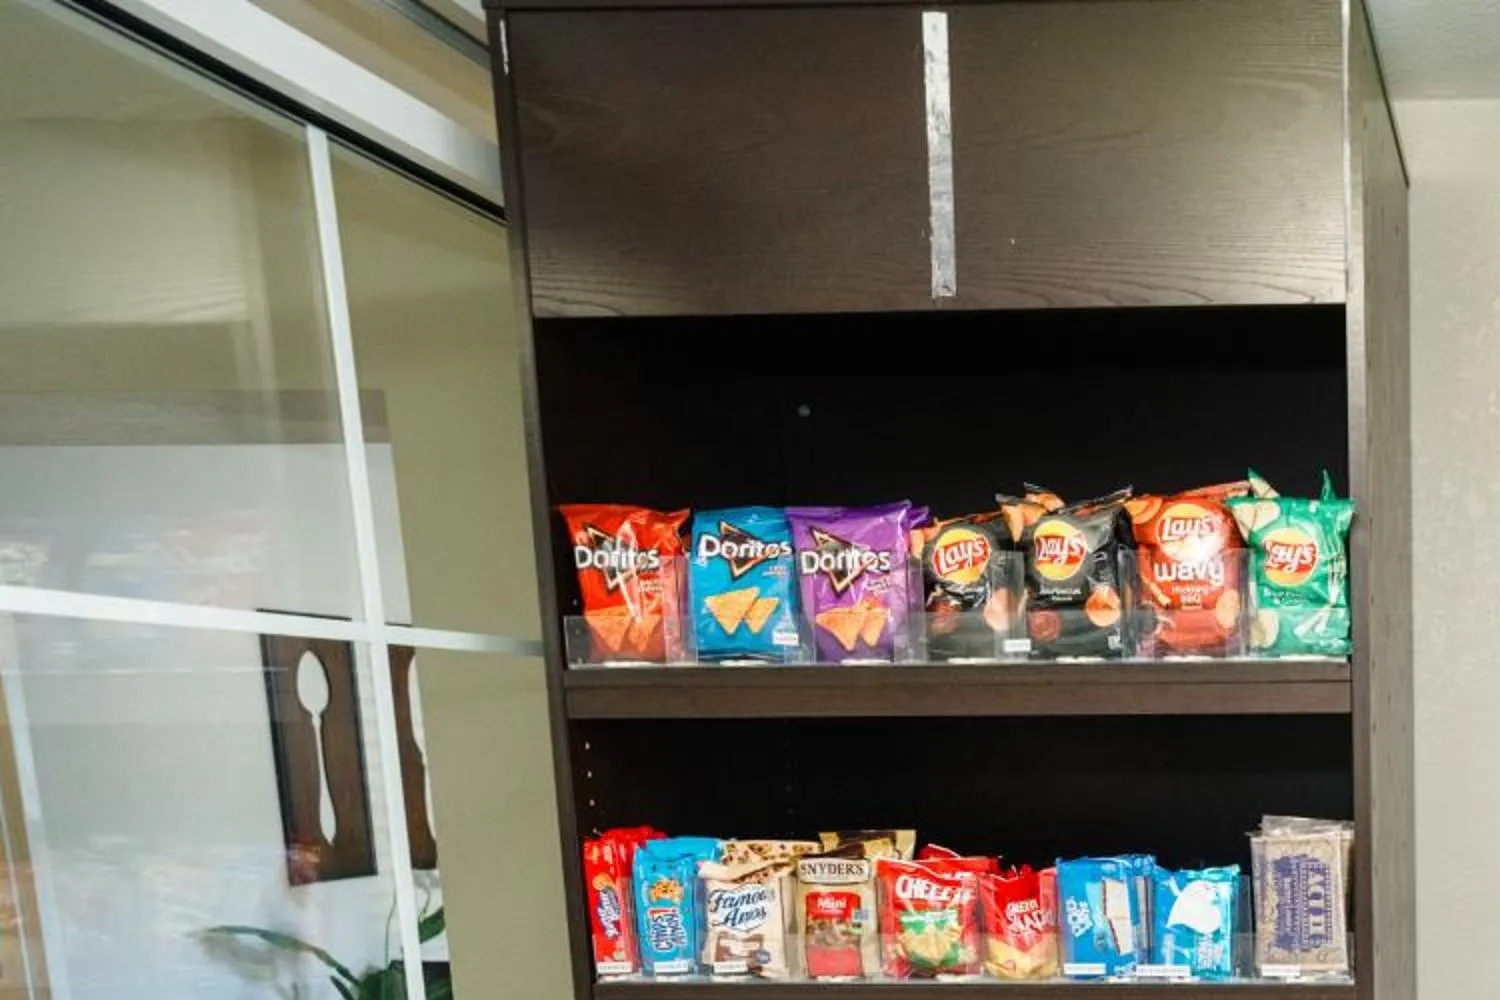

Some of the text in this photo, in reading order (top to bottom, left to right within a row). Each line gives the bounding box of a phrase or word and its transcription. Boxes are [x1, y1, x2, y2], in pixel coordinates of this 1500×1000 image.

[574, 544, 661, 570] Doritos
[699, 534, 793, 560] Doritos
[938, 537, 985, 574] Lay's
[801, 548, 891, 576] Doritos
[1153, 561, 1225, 587] wavy
[800, 863, 865, 876] SNYDER'S
[719, 907, 767, 927] Amos
